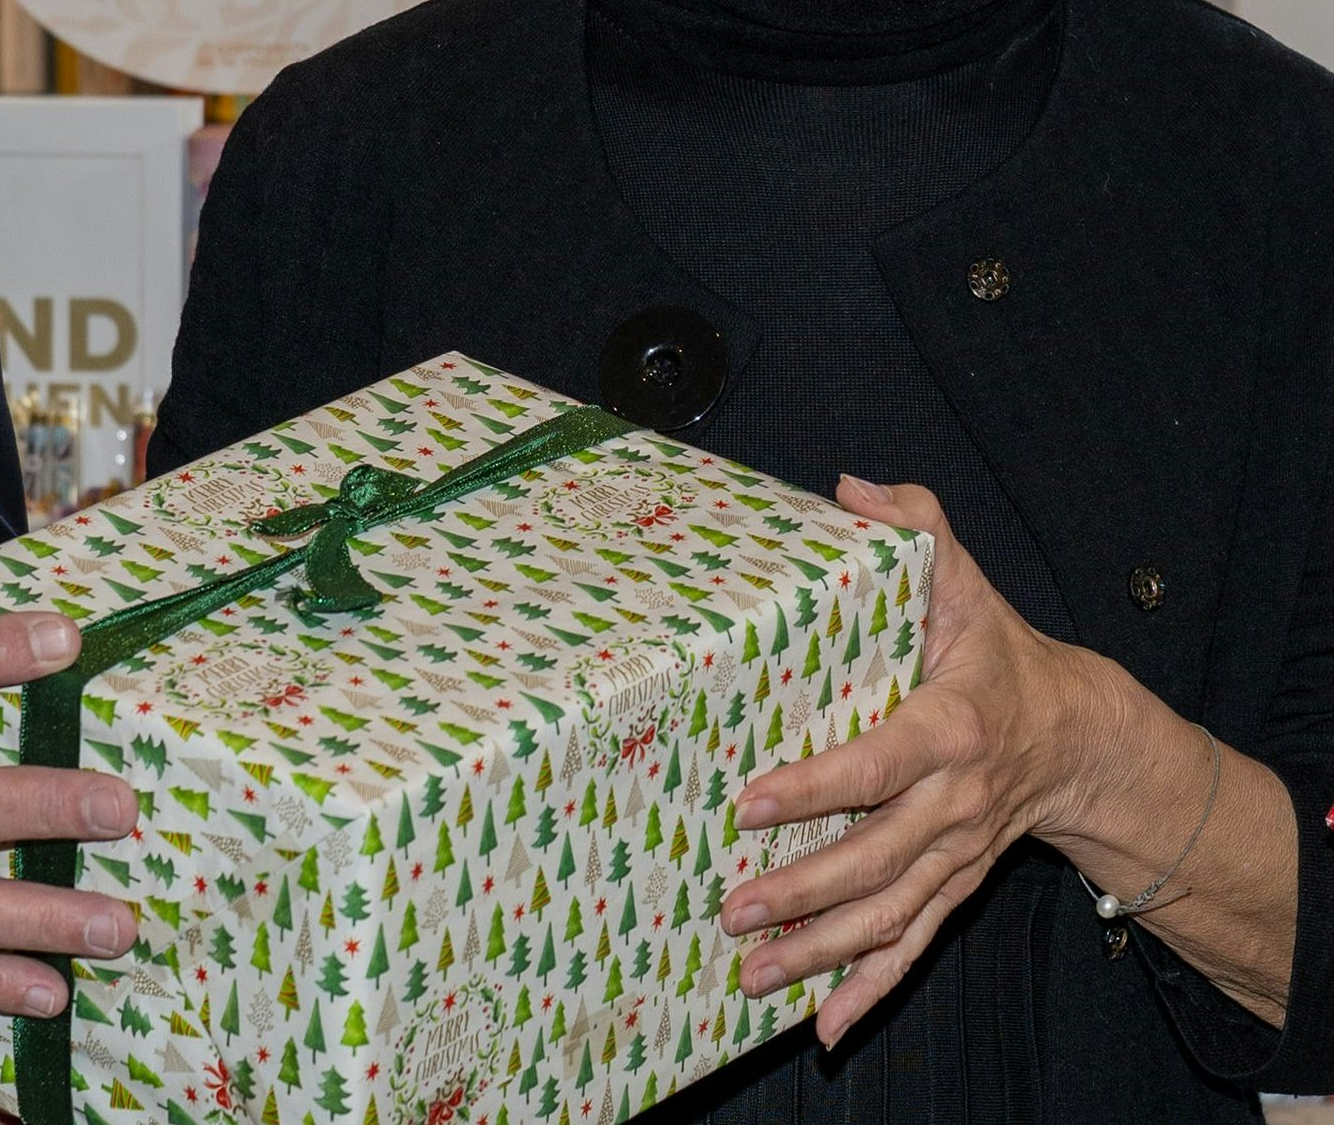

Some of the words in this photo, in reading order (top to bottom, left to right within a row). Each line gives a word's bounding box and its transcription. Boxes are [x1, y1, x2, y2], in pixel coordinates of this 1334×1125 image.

[181, 477, 235, 504] MERRY
[191, 480, 265, 515] CHRISTMAS
[569, 483, 620, 510] MERRY
[580, 484, 651, 521] CHRISTMAS
[195, 655, 250, 685] MERRY
[602, 654, 655, 692] MERRY
[608, 667, 671, 718] CHRISTMAS
[424, 1010, 469, 1056] MERRY
